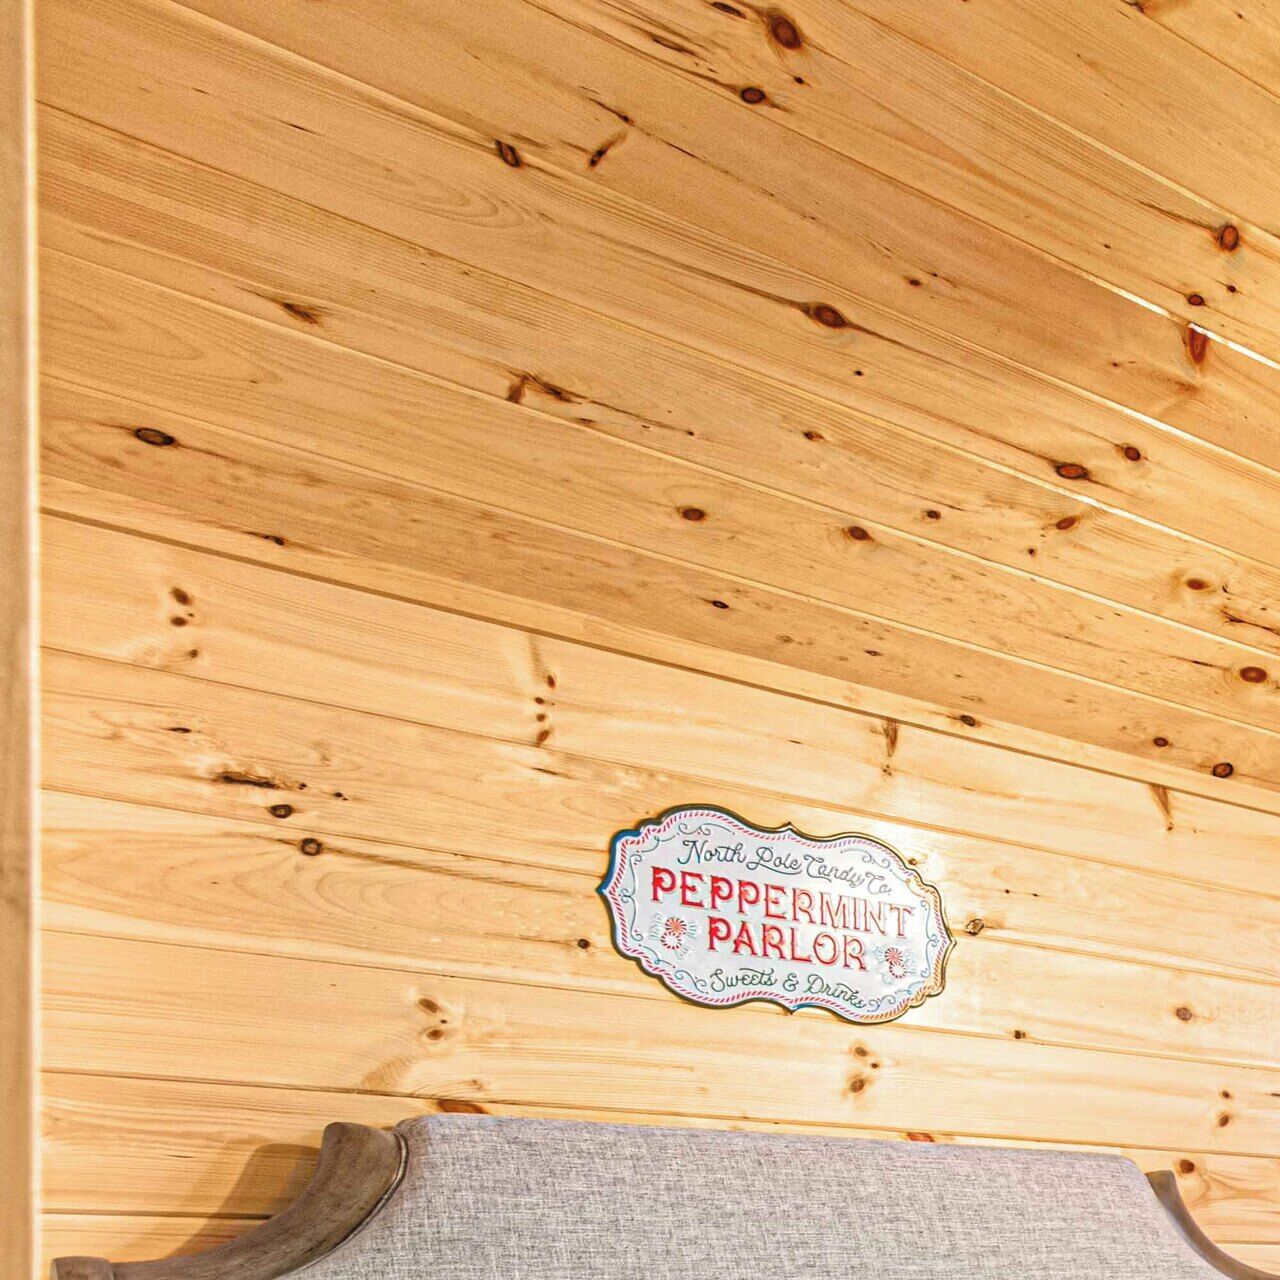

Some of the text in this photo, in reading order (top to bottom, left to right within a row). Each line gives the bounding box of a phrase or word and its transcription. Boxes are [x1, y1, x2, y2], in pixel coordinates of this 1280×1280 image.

[678, 839, 747, 866] North
[747, 846, 804, 876] Pole
[804, 855, 867, 889] Candy
[651, 866, 914, 940] PEPPERMINT
[707, 915, 867, 972] PARLOR
[710, 967, 867, 1009] Sweets & Drinks
